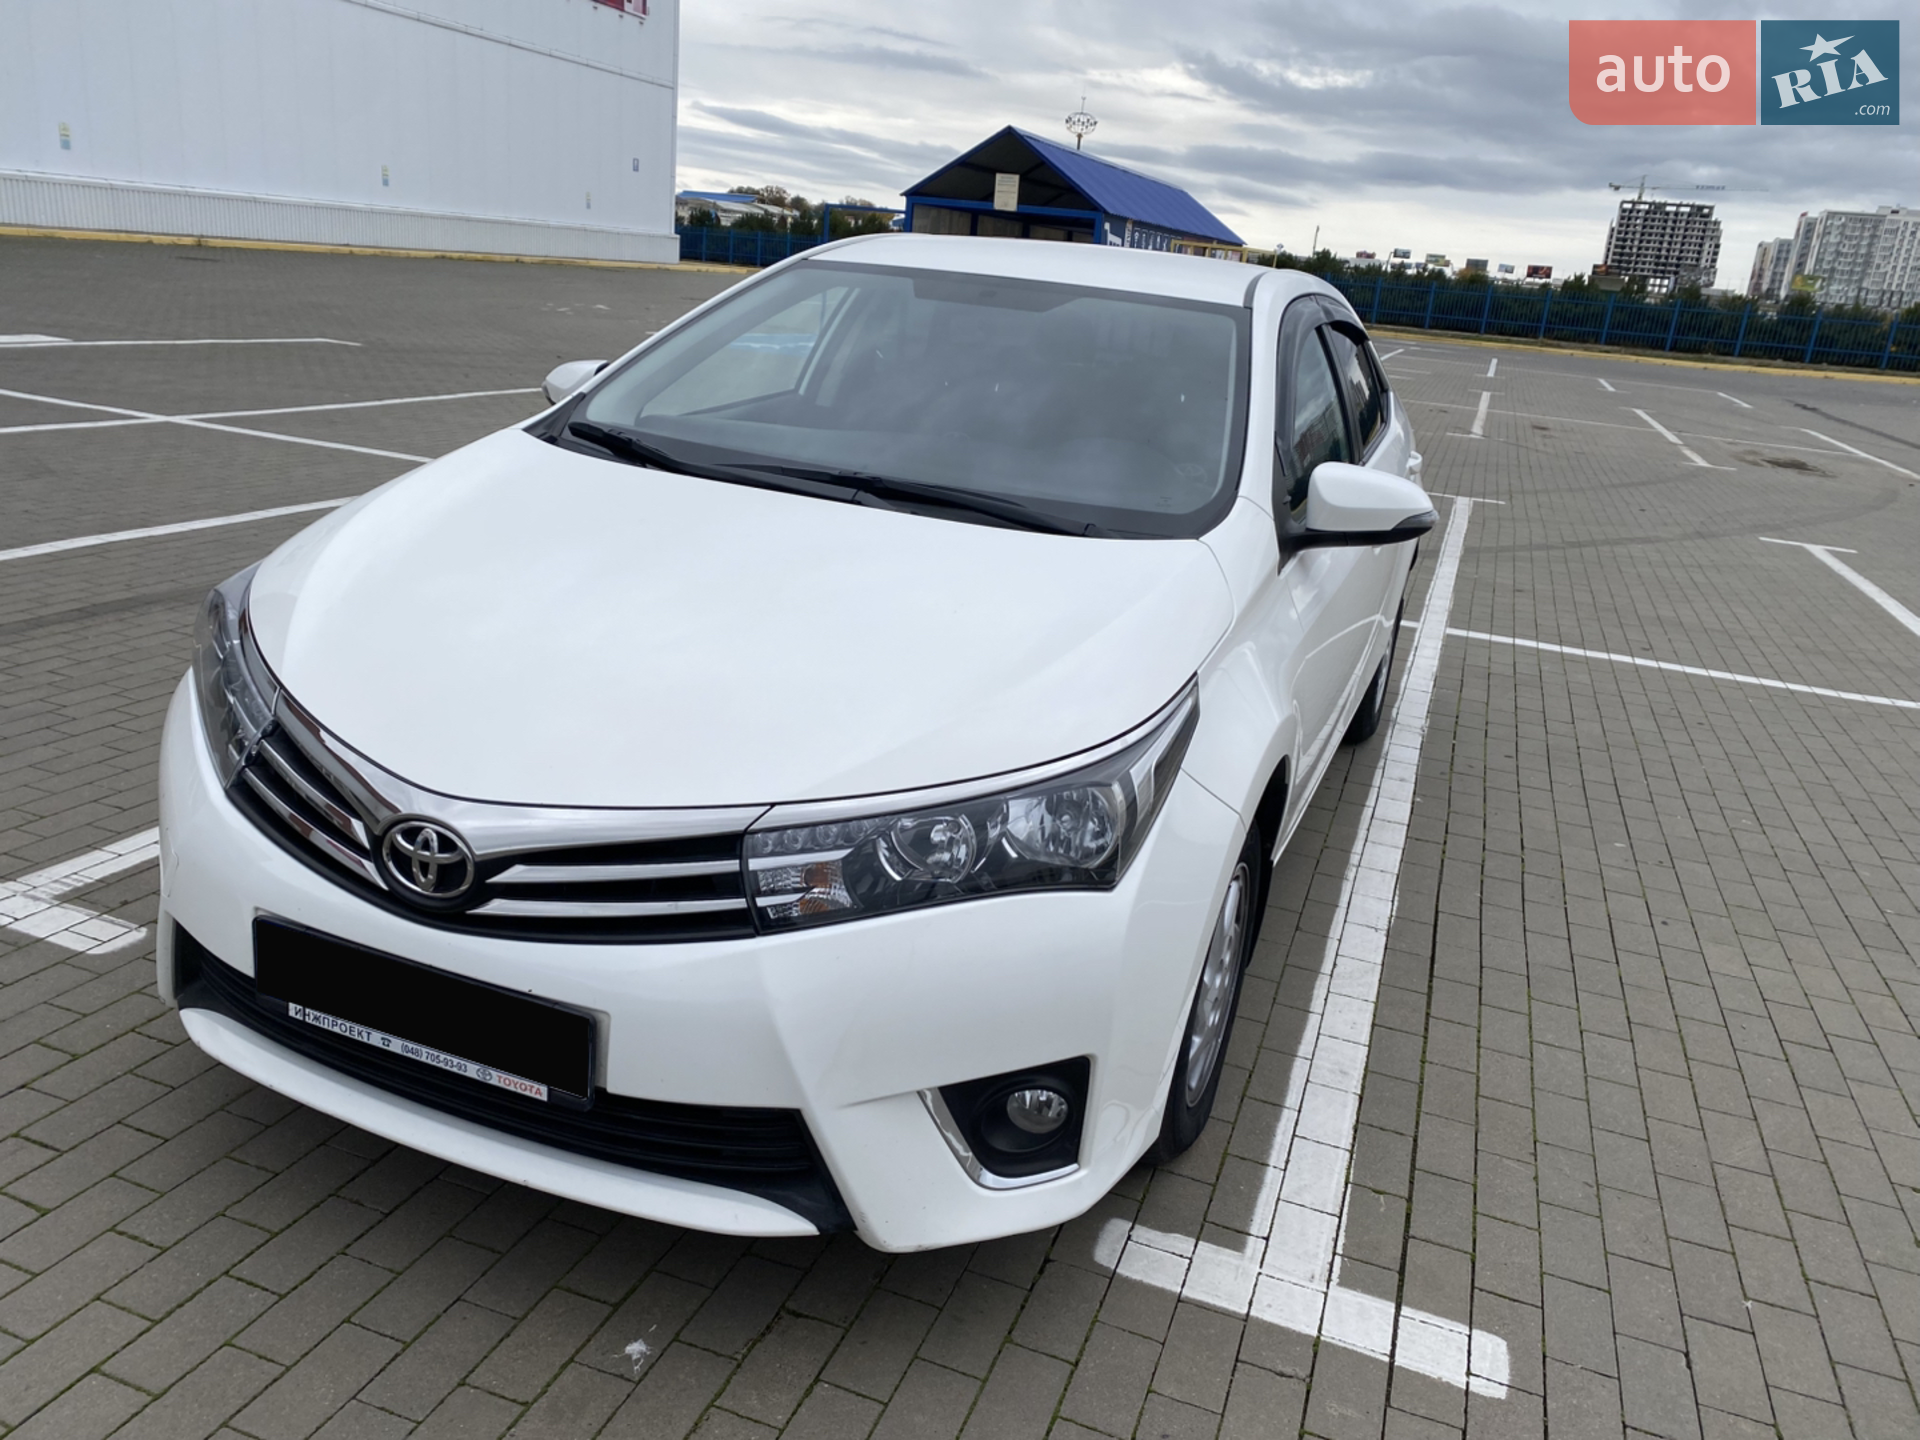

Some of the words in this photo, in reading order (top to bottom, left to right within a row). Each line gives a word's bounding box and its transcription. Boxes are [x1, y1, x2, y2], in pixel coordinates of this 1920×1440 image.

[294, 1006, 373, 1041] ИНЖПРОЕКТ
[401, 1042, 424, 1060] (048)
[425, 1051, 468, 1074] 705-93-93
[496, 1074, 543, 1097] TOYOTA
